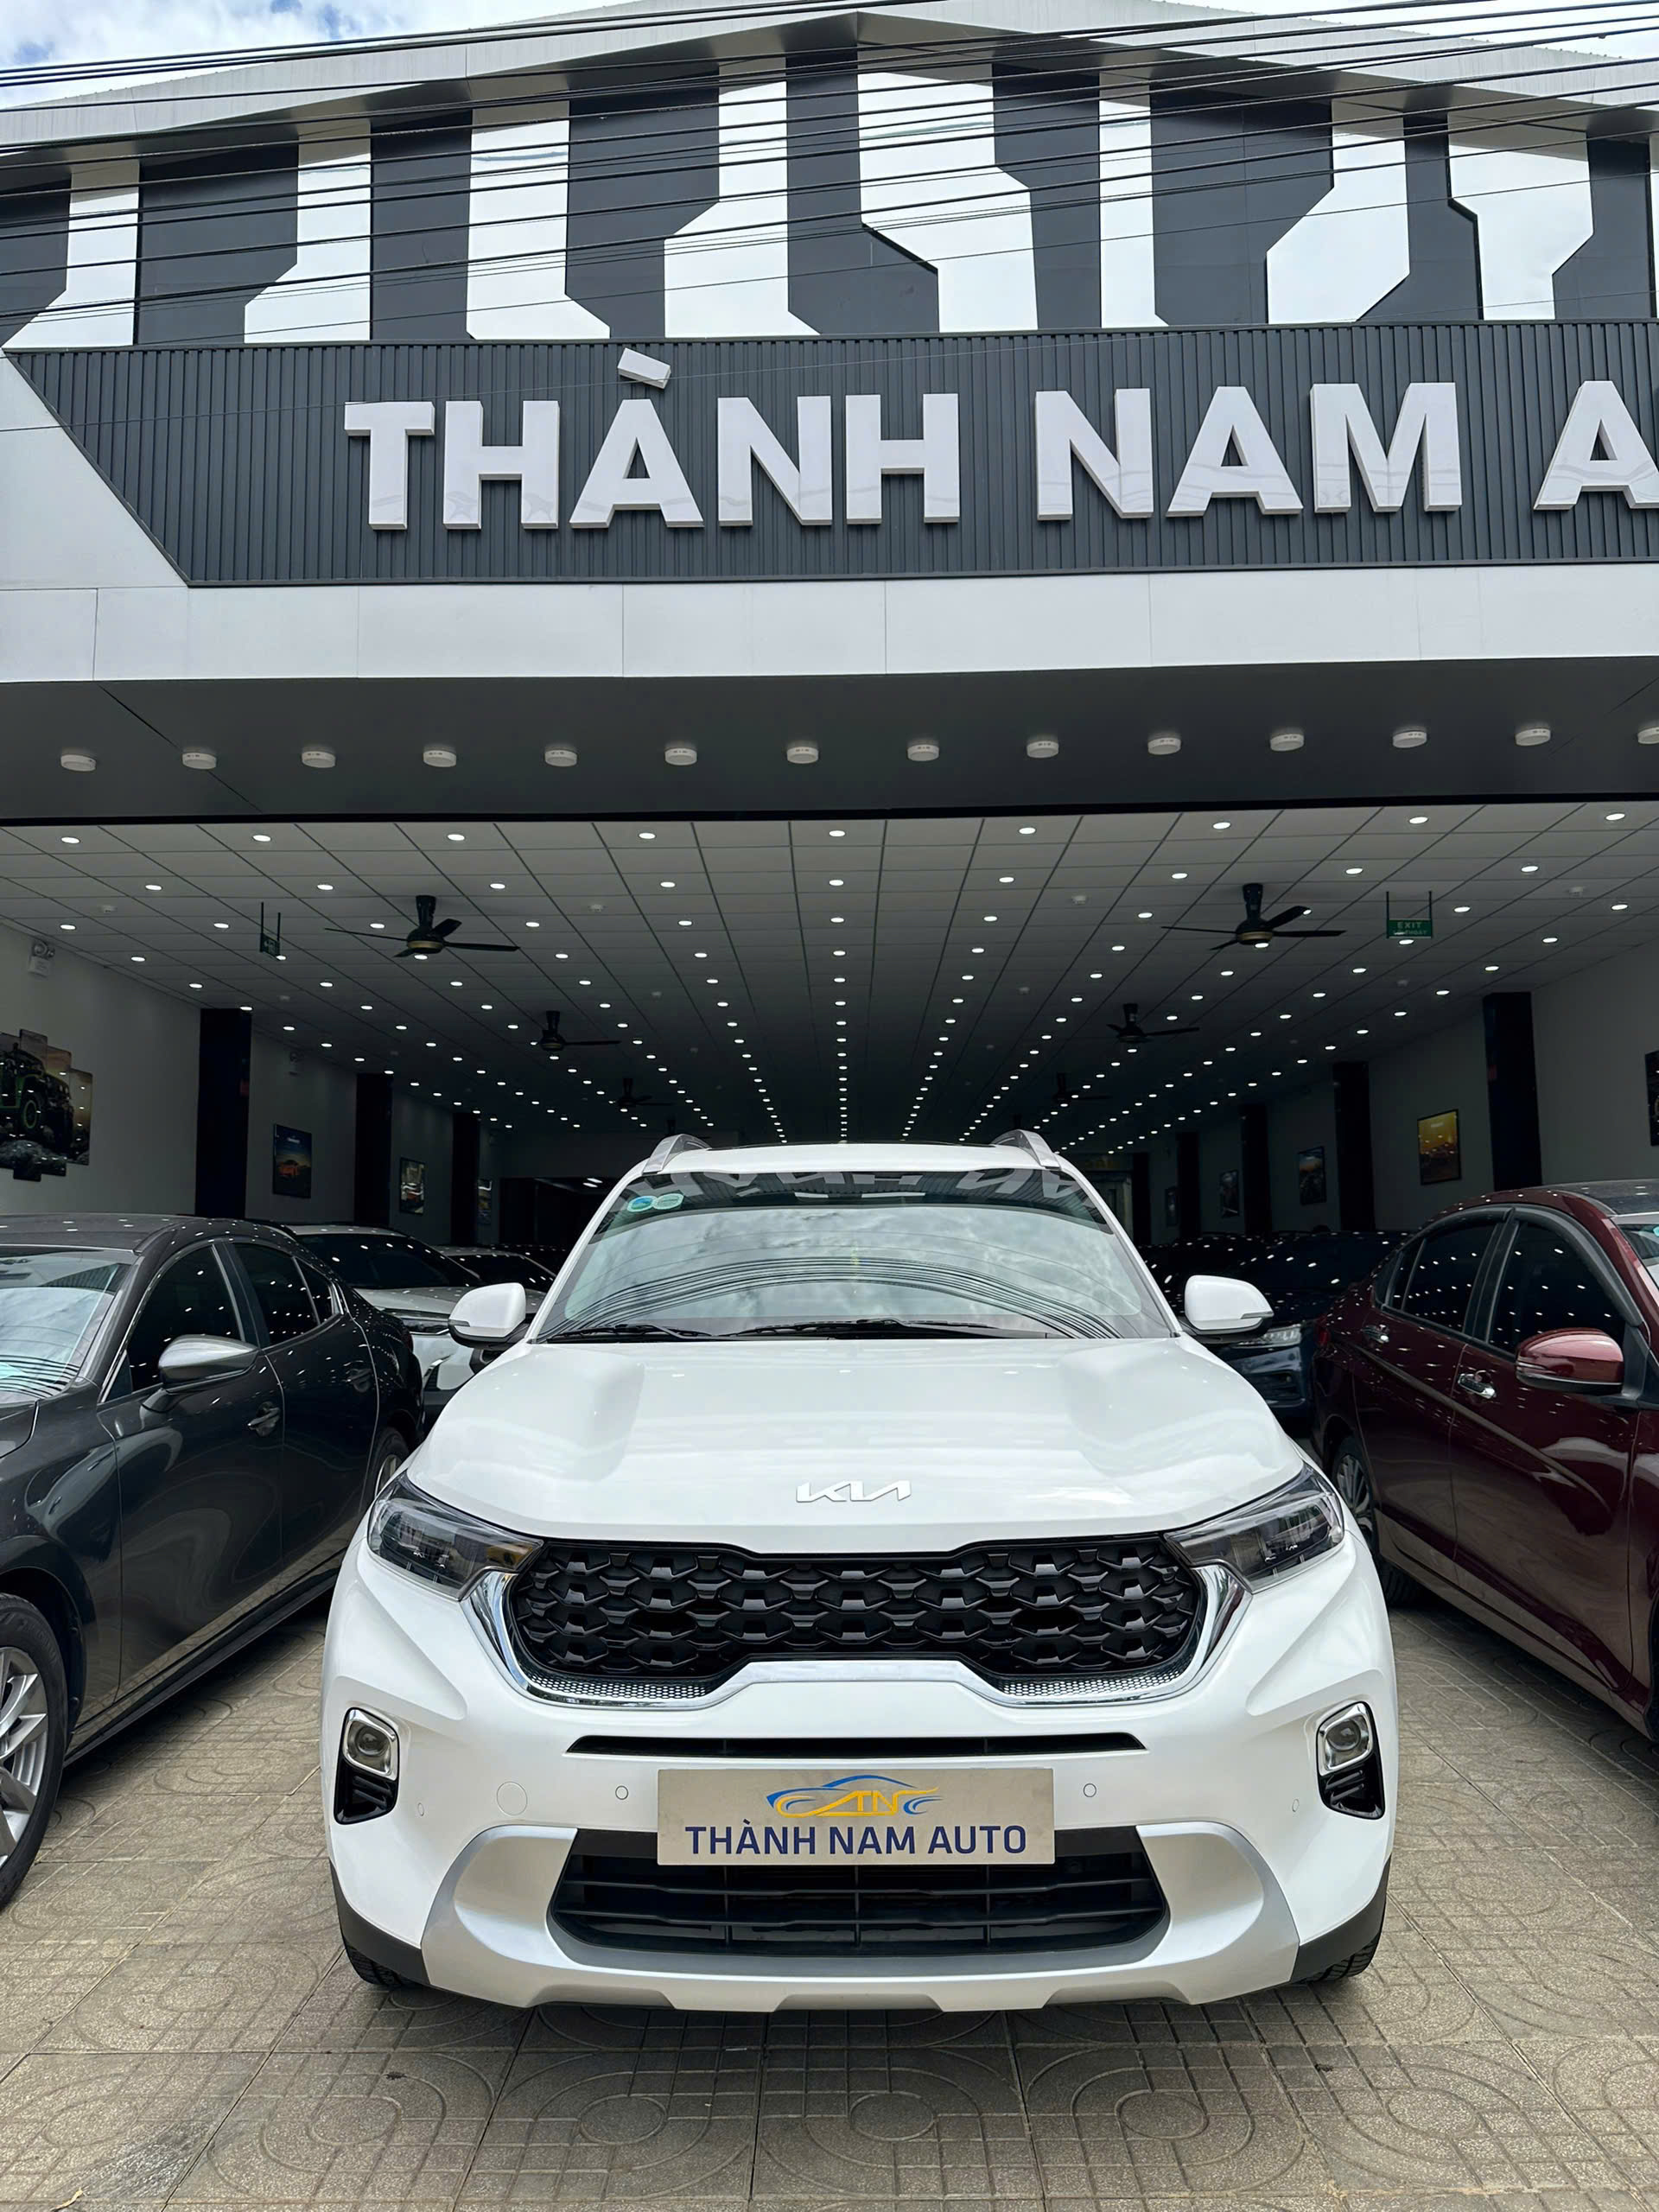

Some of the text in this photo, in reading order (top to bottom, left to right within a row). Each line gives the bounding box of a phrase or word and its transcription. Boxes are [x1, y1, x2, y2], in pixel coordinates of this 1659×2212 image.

[344, 347, 959, 530] THÀNH
[1036, 382, 1463, 520] NAM
[684, 1818, 1027, 1855] THÀNH NAM AUTO
